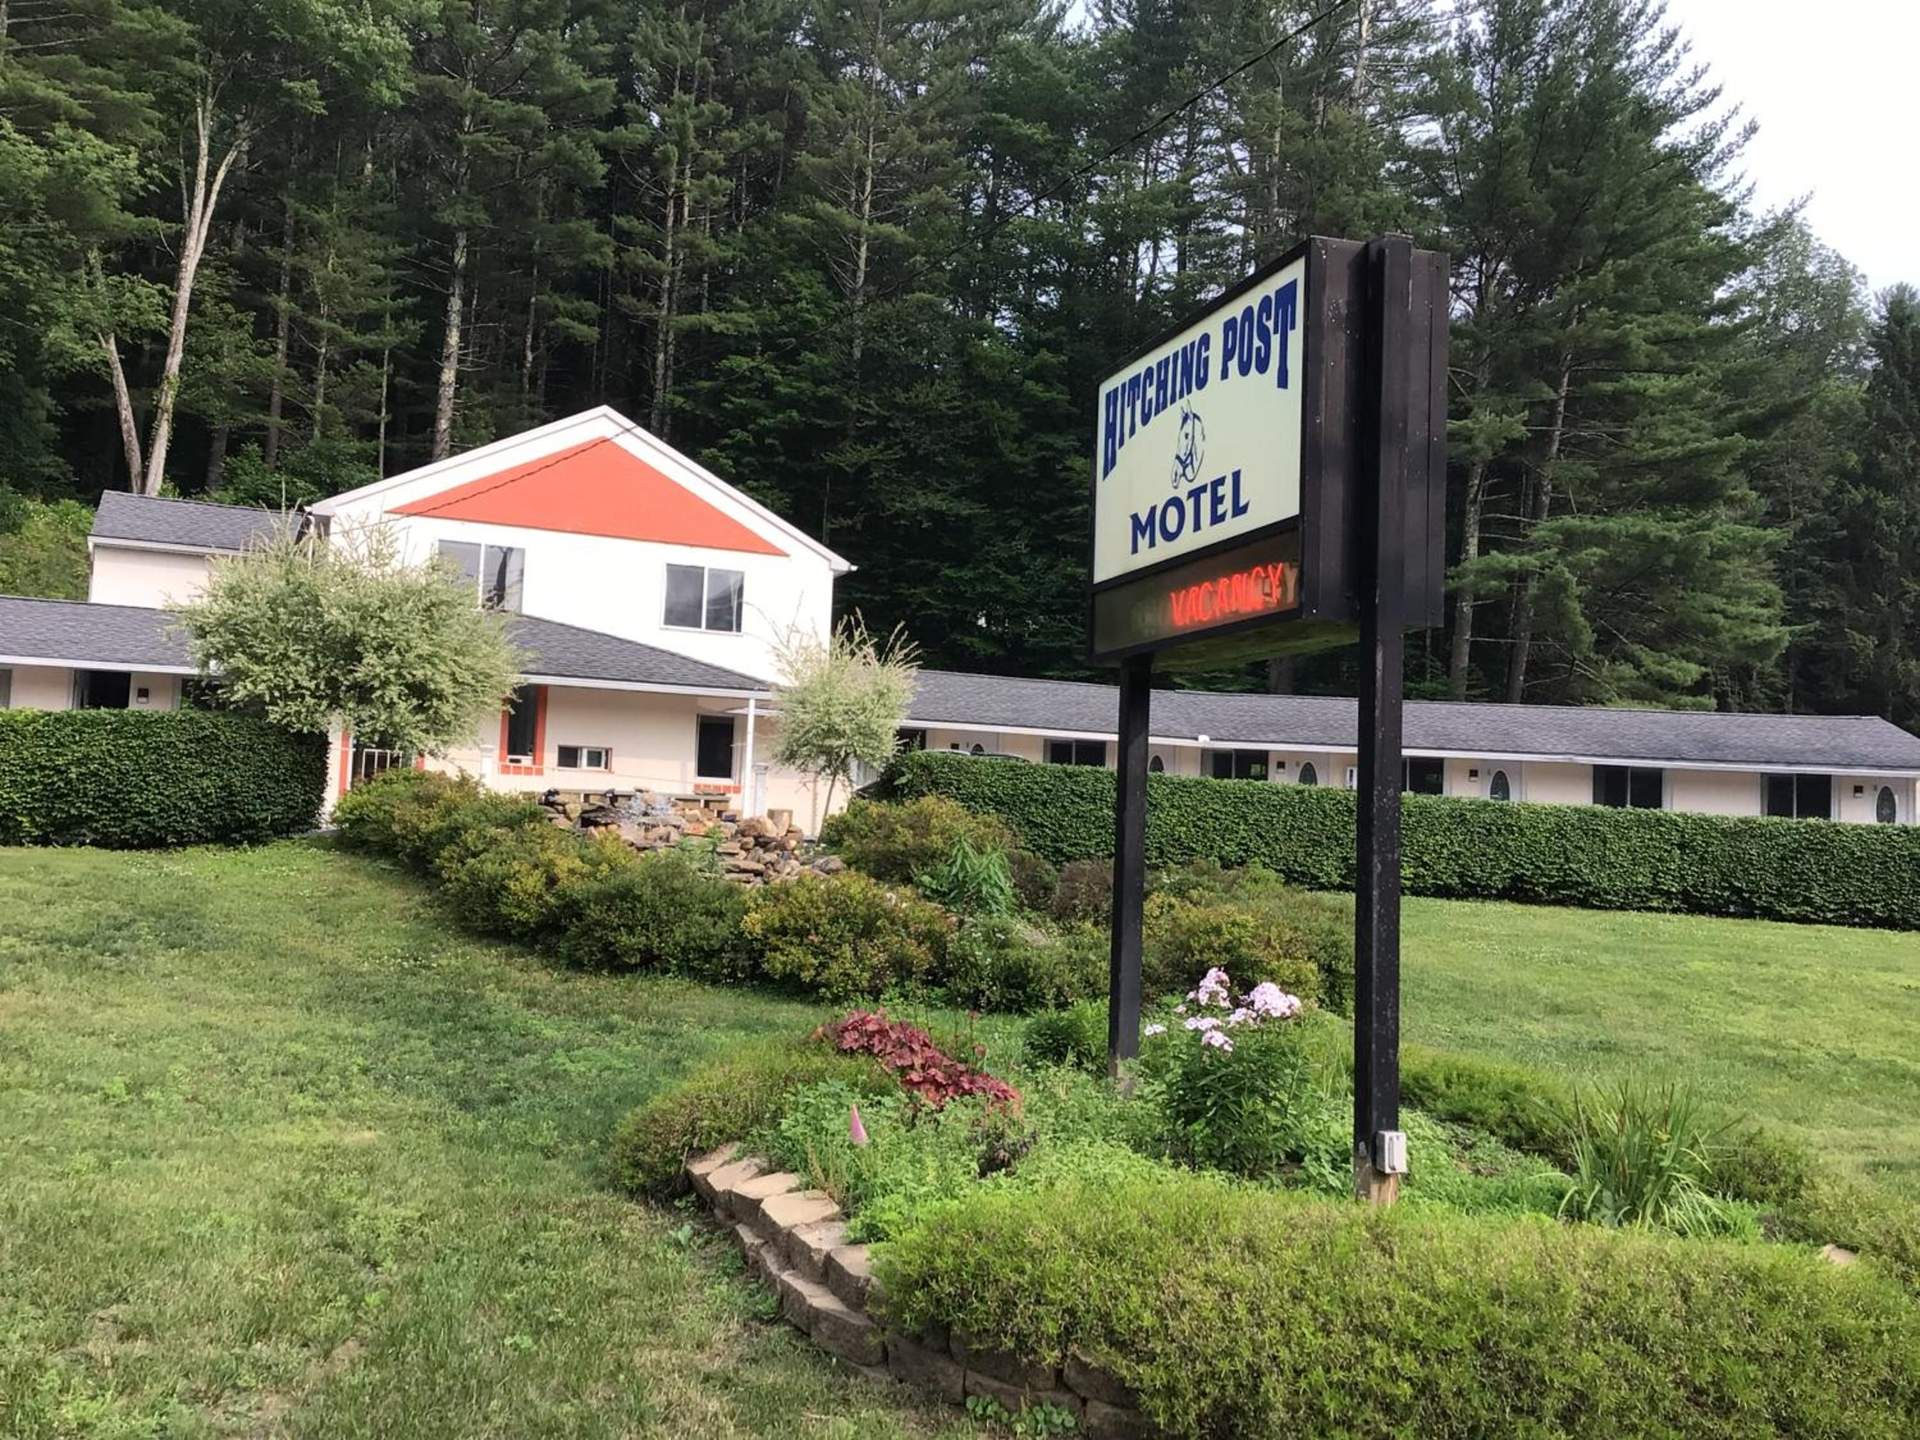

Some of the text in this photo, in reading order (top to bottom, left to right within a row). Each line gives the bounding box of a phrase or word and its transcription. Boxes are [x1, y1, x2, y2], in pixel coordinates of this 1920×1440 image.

[1103, 278, 1298, 481] HITCHING POST
[1130, 469, 1249, 555] MOTEL
[1169, 562, 1284, 627] VACANCY
